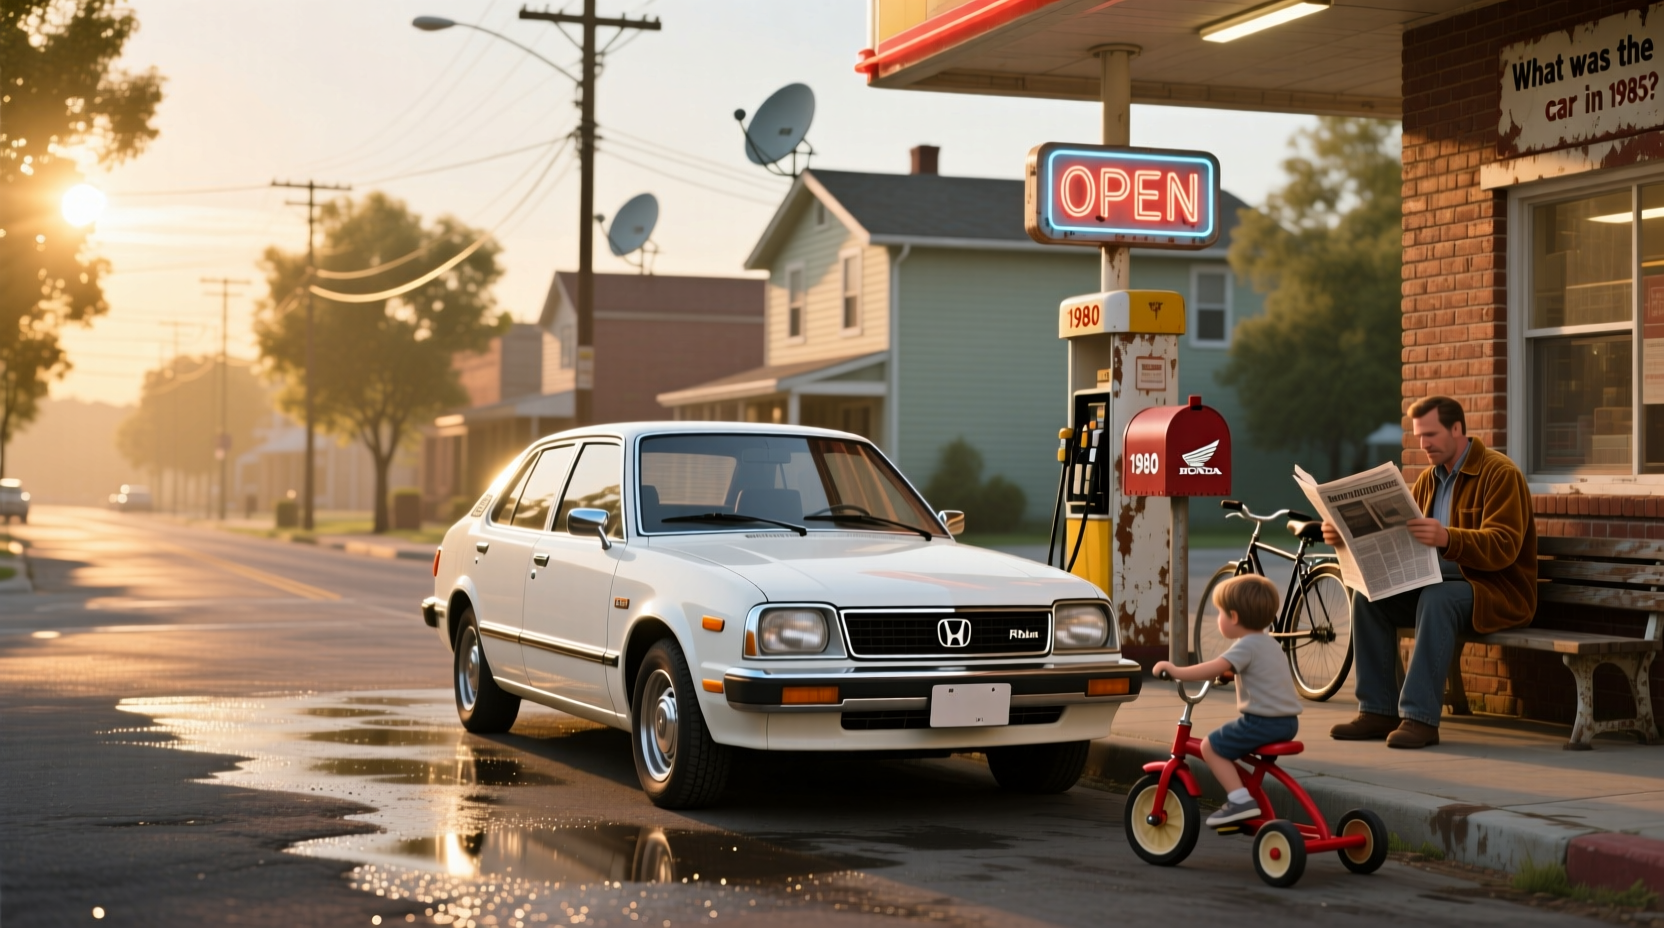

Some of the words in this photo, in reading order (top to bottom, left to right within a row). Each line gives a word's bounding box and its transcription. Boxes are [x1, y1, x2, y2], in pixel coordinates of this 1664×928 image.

[1512, 53, 1564, 91] What
[1569, 48, 1611, 78] was
[1617, 34, 1653, 67] the
[1545, 95, 1578, 122] car
[1585, 84, 1603, 114] in
[1609, 71, 1659, 108] 1985?
[1060, 165, 1198, 222] OPEN
[1068, 304, 1100, 328] 1980
[1129, 452, 1159, 475] 1980
[1178, 466, 1223, 475] HONDA
